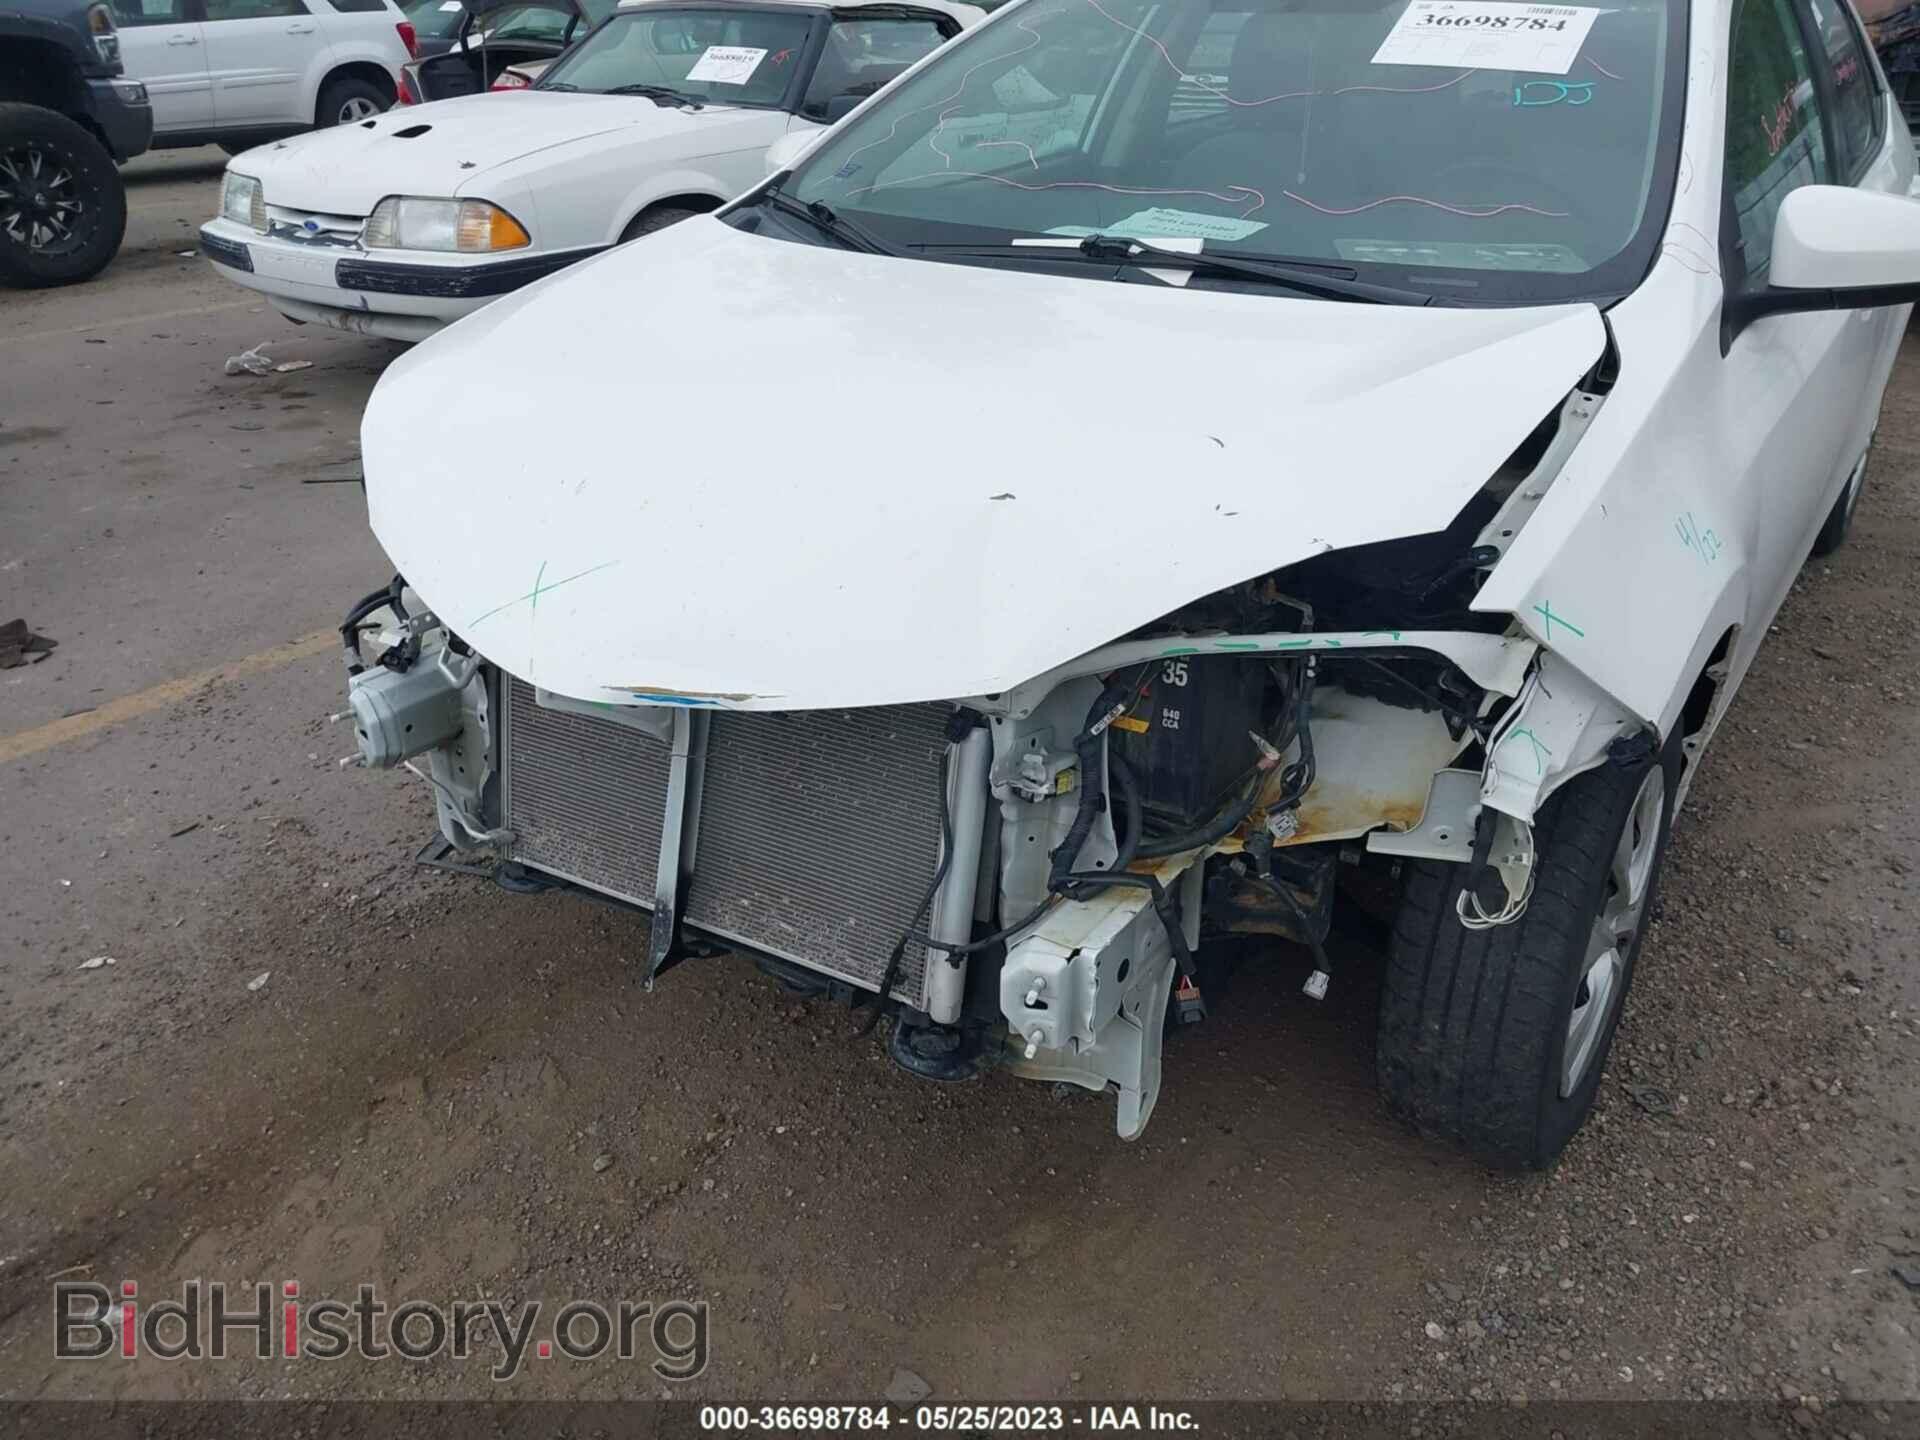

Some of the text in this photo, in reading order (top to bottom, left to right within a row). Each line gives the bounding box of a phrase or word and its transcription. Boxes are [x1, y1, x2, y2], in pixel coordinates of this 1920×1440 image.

[1416, 14, 1567, 32] 36698784
[1161, 660, 1188, 687] 35
[1161, 718, 1179, 729] CCA
